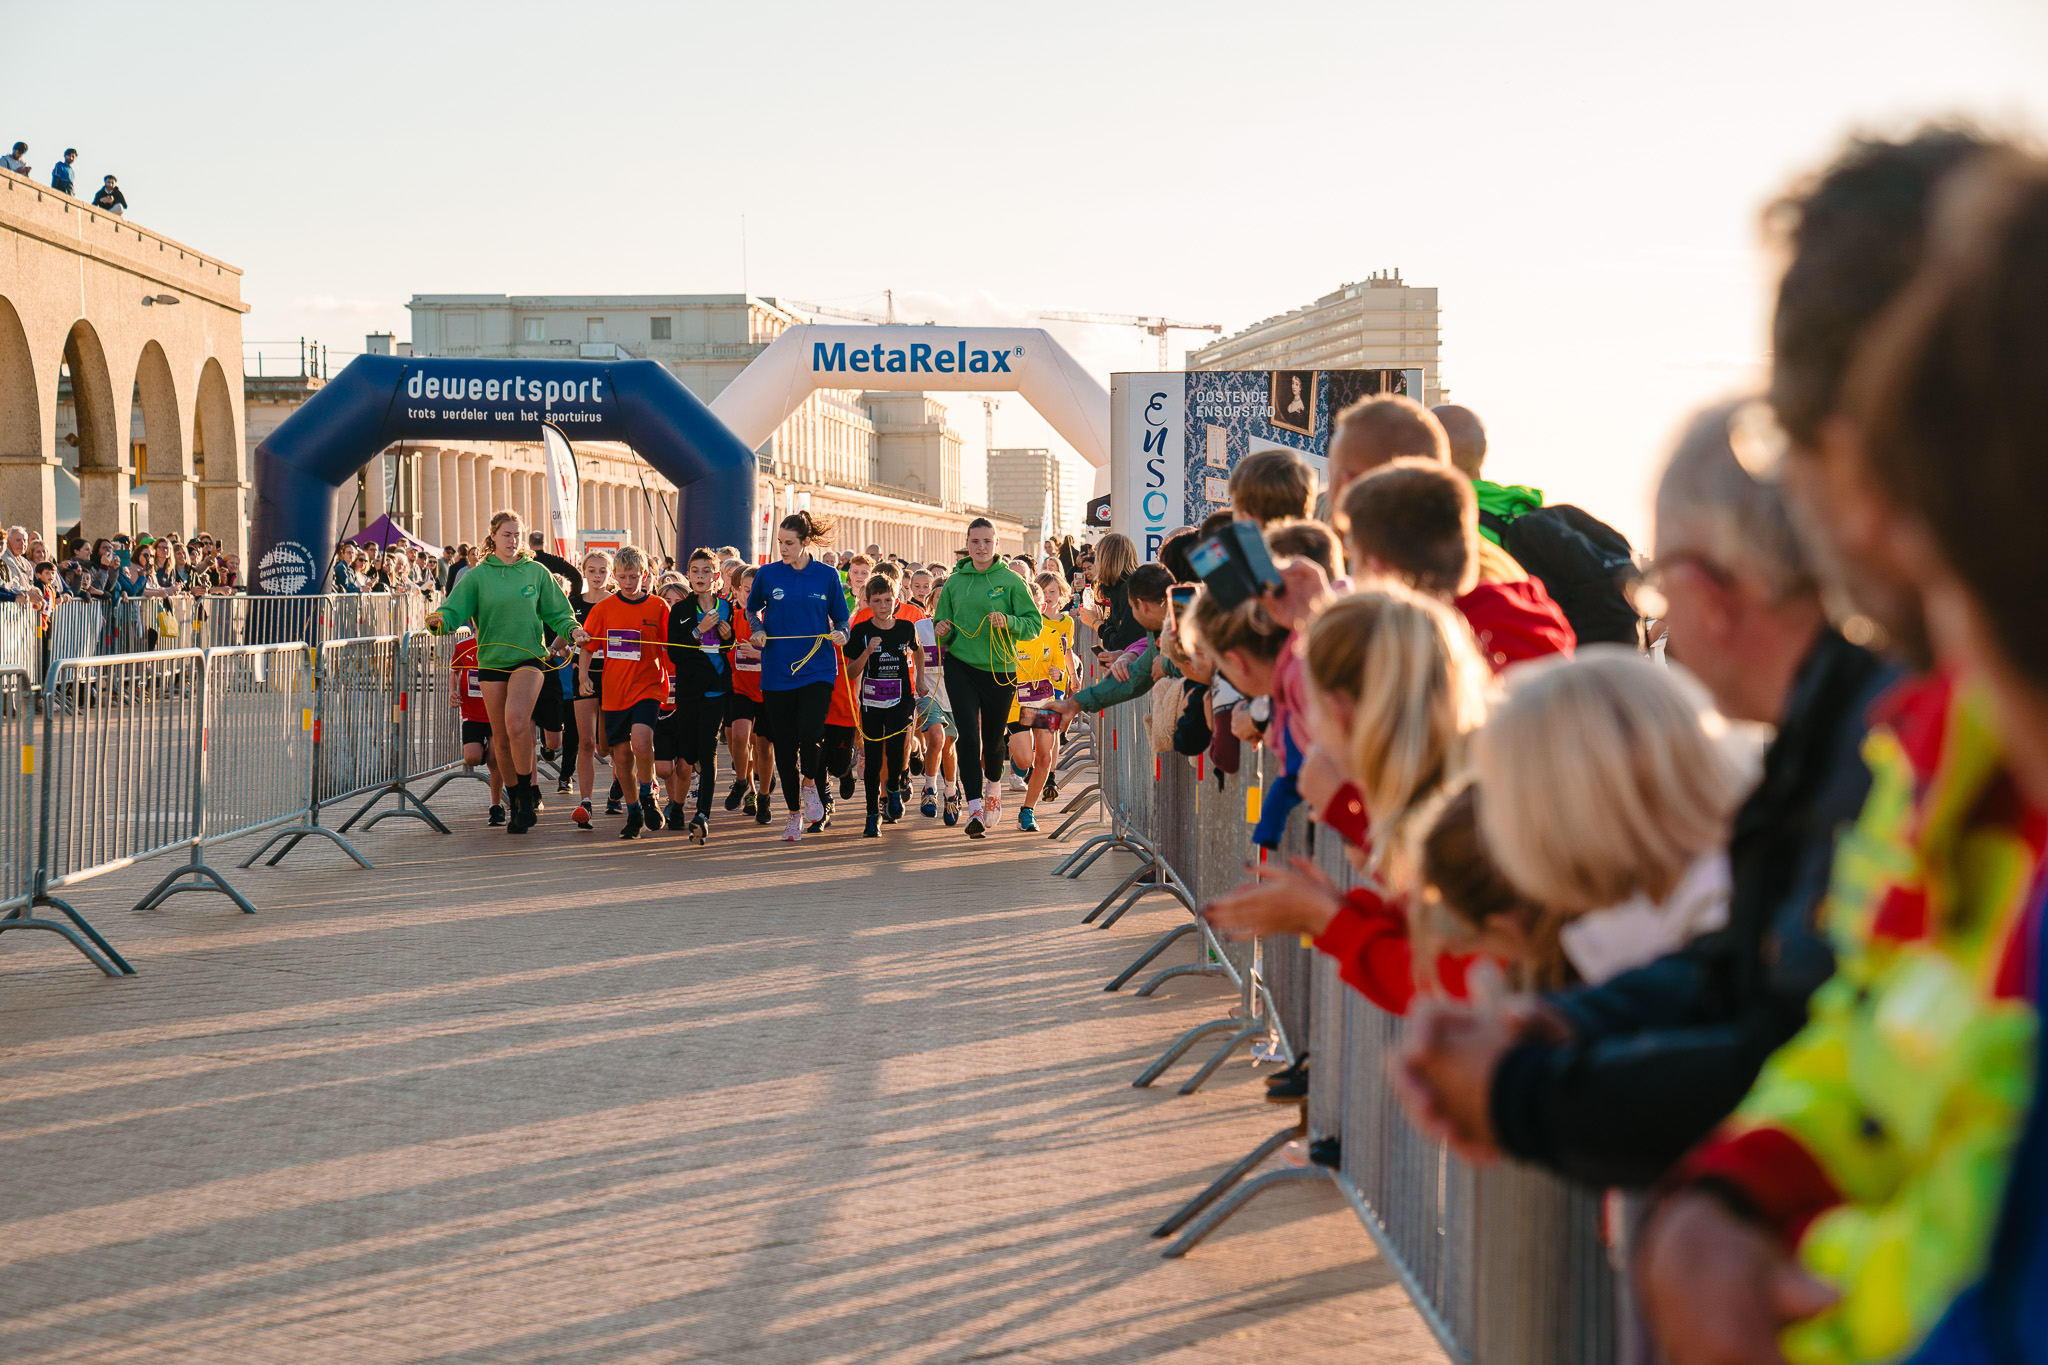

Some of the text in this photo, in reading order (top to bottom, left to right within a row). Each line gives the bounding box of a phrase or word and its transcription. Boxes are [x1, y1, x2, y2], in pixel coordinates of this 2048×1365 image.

[407, 370, 602, 411] deweertsport
[1196, 391, 1268, 403] OOSTENDE
[408, 408, 436, 419] trots
[442, 408, 488, 421] verdeler
[521, 409, 539, 422] het
[545, 411, 602, 424] sportvirus
[1196, 405, 1276, 418] ENSORSTAD
